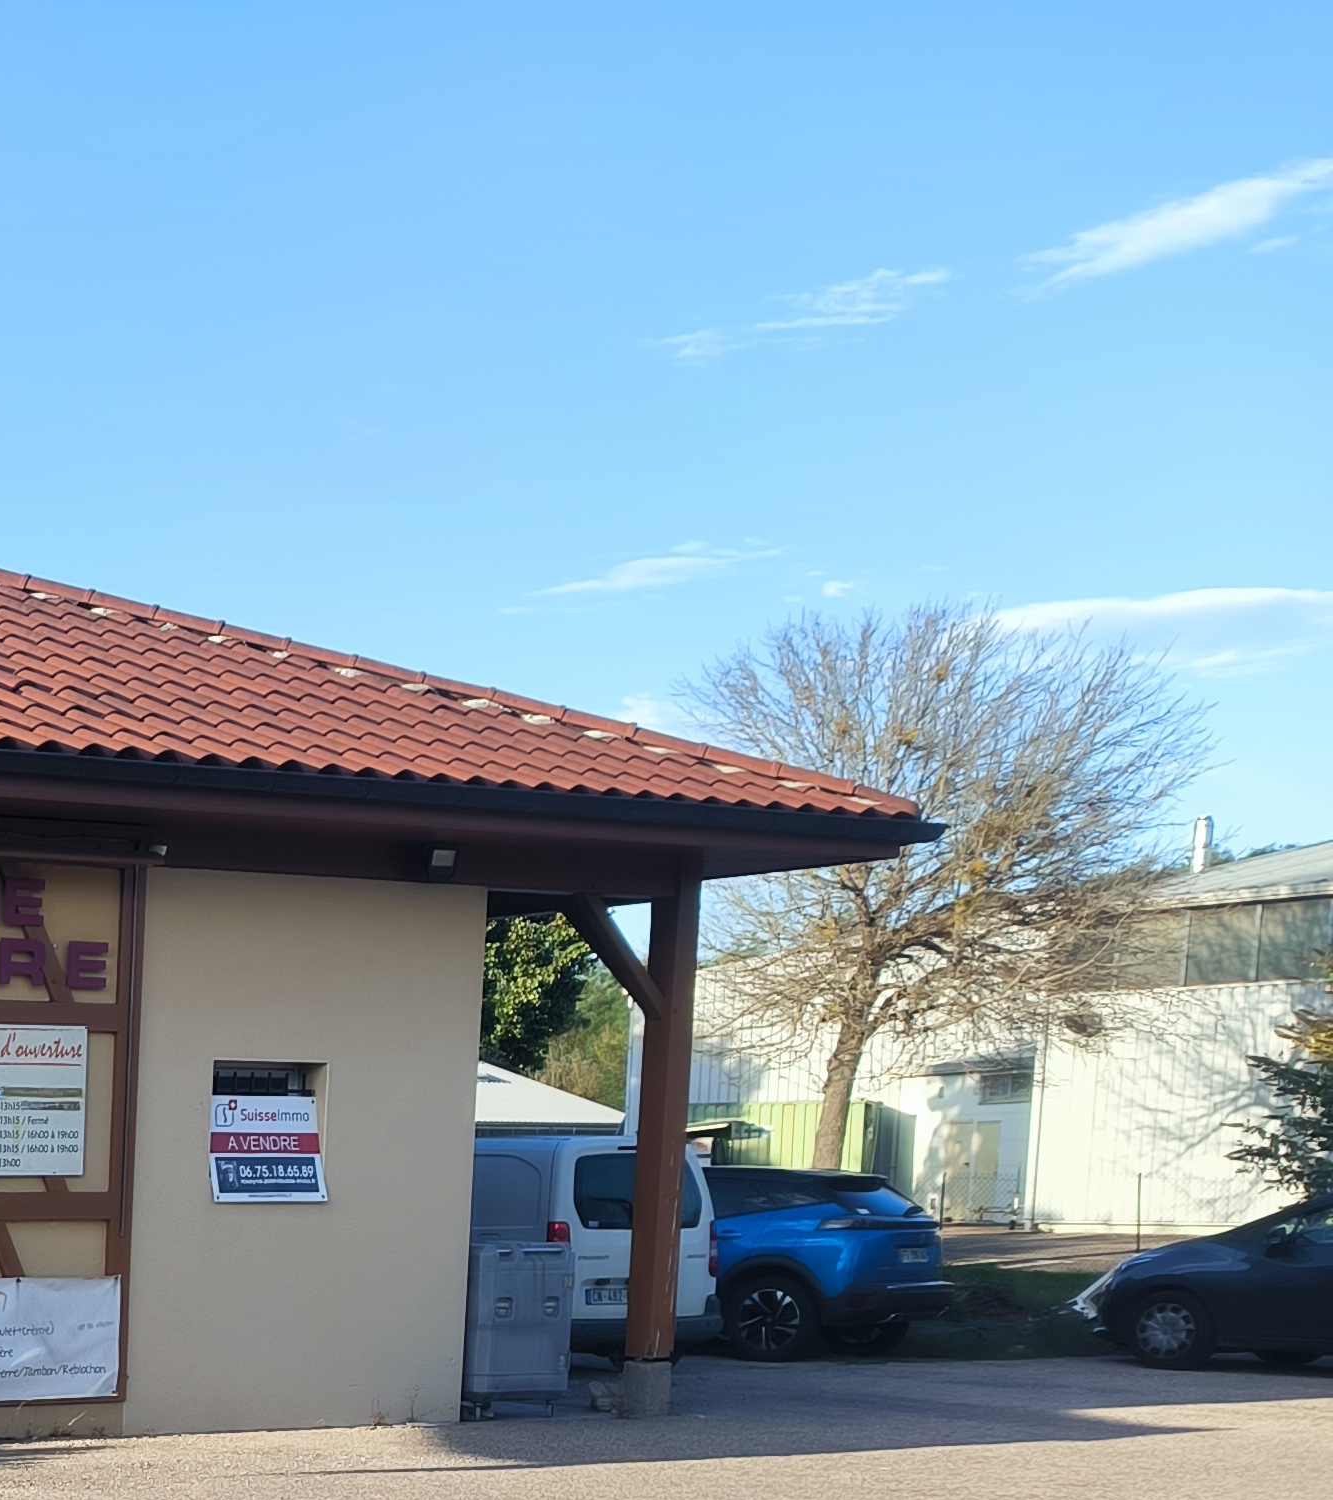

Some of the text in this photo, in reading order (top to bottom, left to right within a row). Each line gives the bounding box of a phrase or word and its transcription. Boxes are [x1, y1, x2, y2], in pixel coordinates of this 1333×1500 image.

[1, 1032, 83, 1058] d'ouverture
[228, 1136, 300, 1150] A VENDRE
[239, 1165, 314, 1178] 06.75.18.65.89
